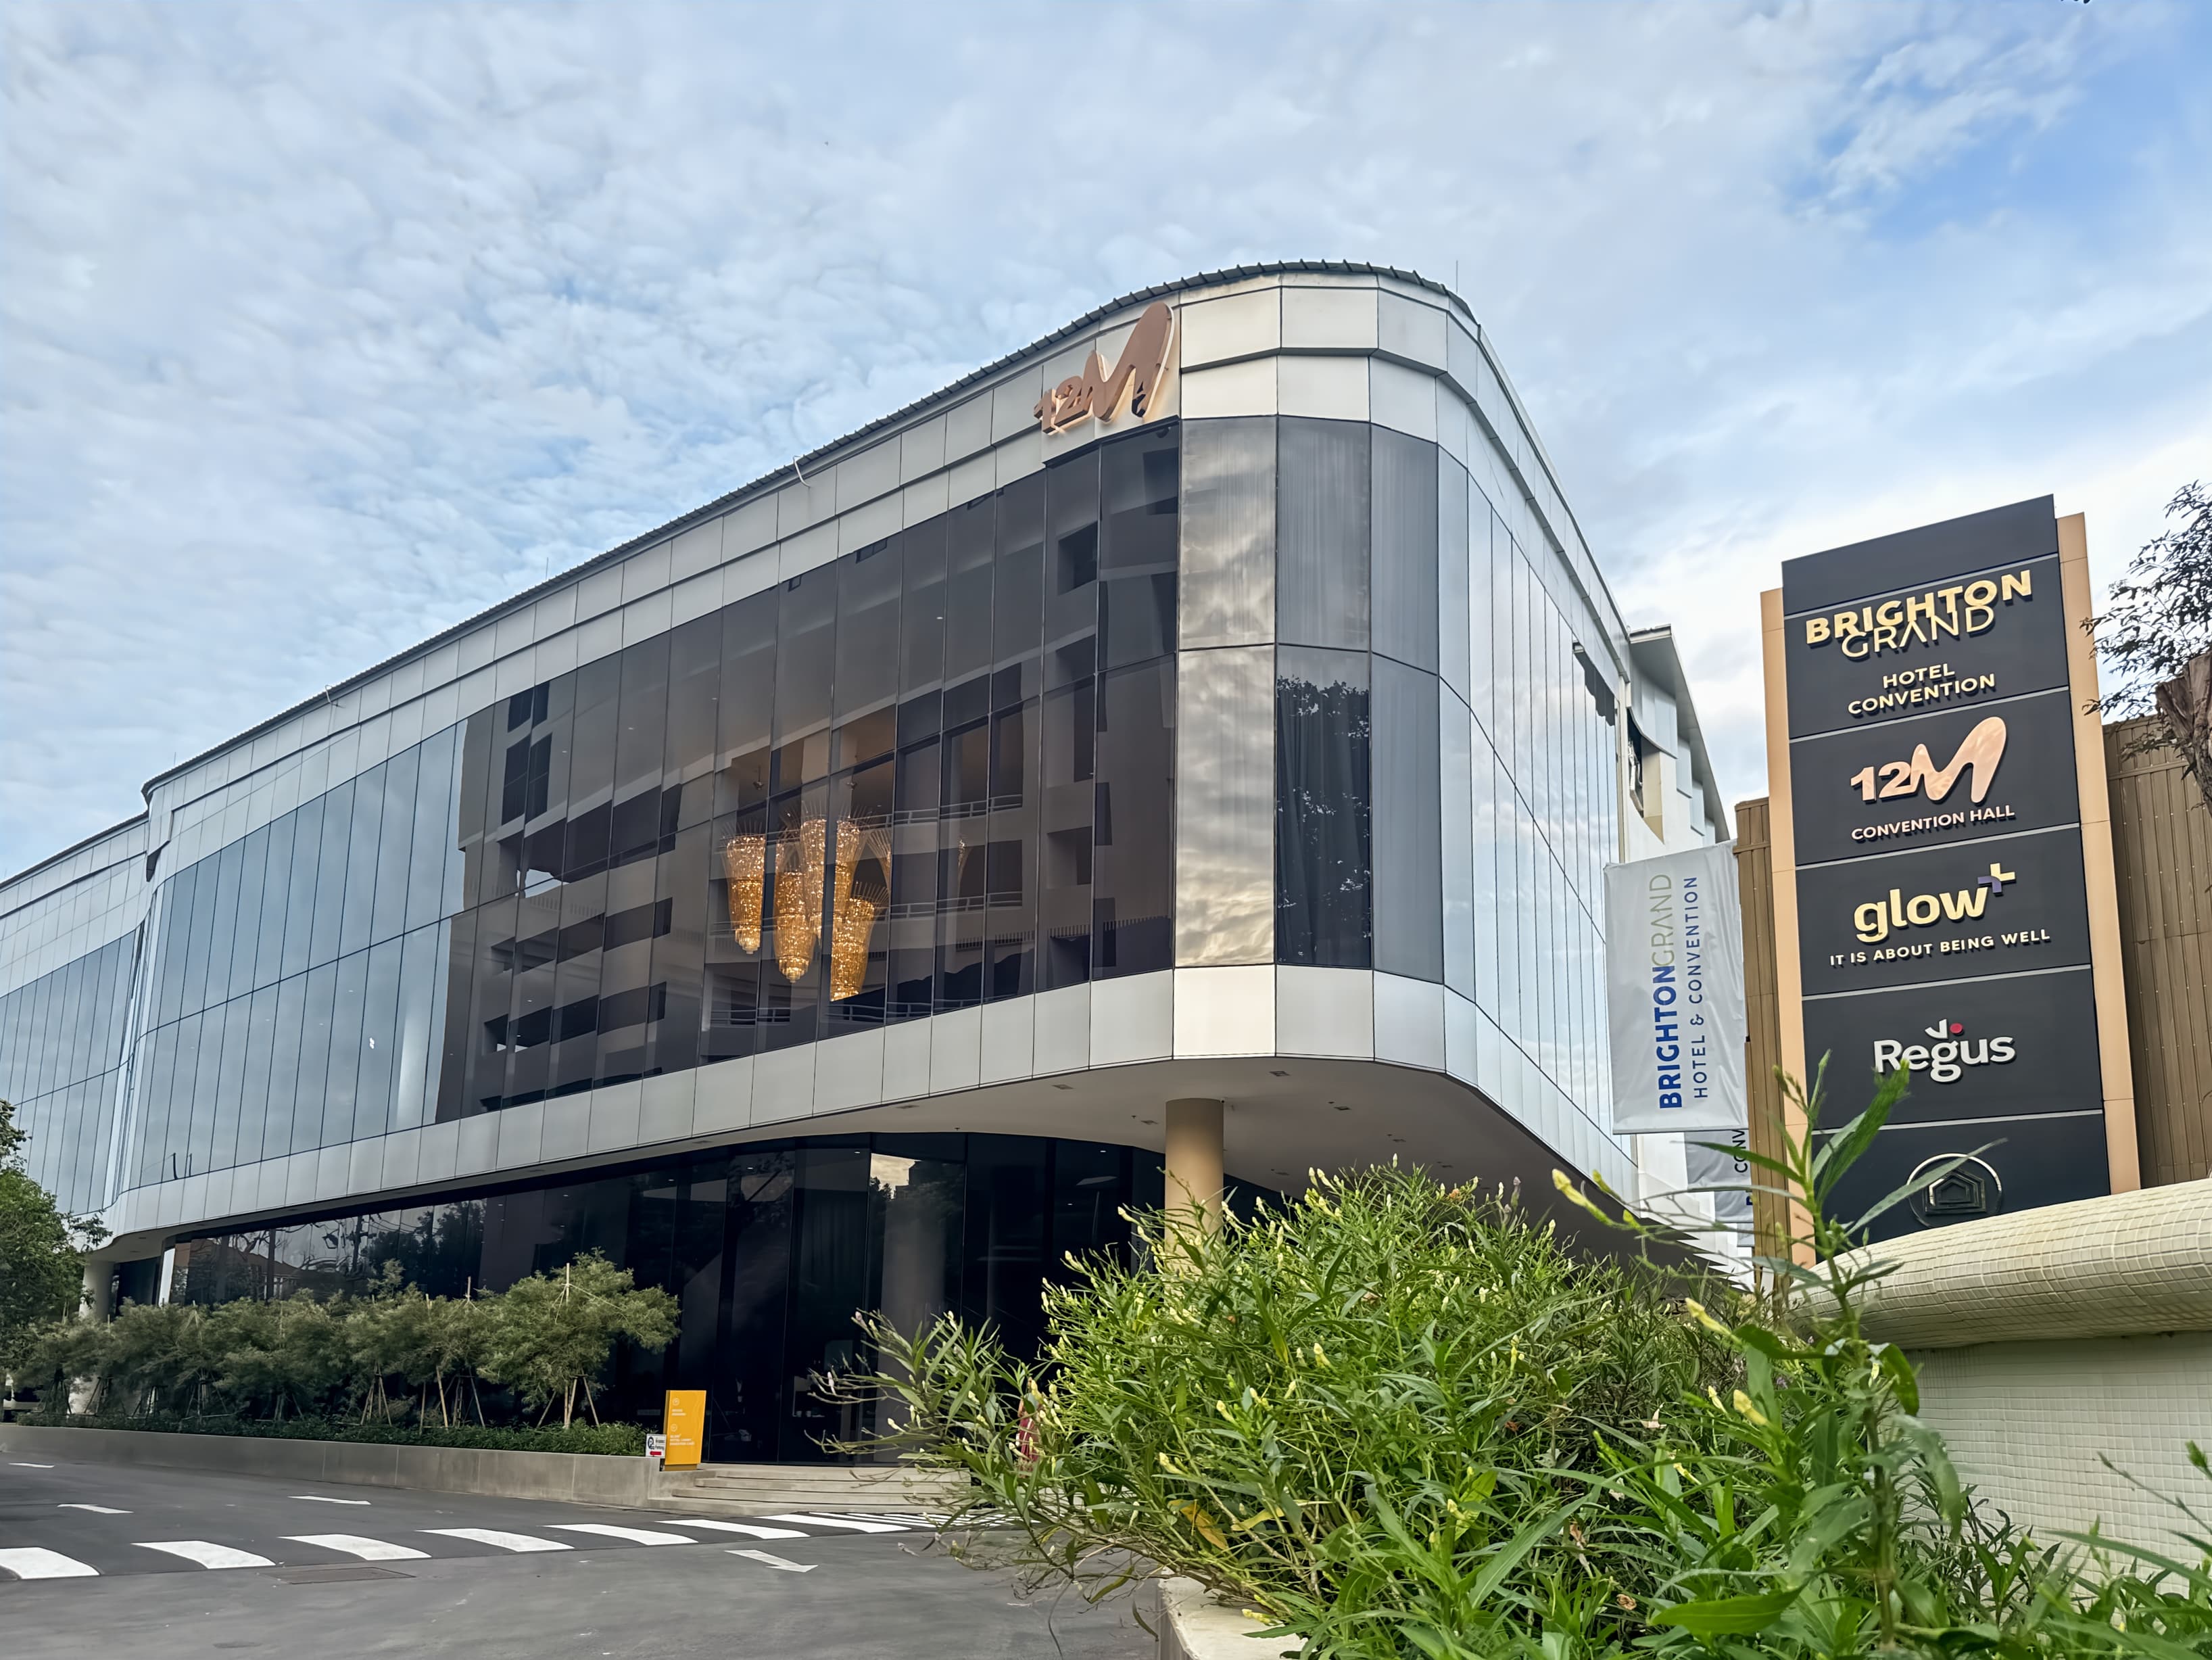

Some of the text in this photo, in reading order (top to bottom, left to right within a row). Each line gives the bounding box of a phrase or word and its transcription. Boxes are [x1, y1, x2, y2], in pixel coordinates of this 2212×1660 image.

[1034, 302, 1175, 434] 12M
[1806, 569, 2031, 644] BRIGHTON
[1841, 605, 1995, 658] GRAND
[1848, 673, 1995, 715] CONVENTION
[1883, 663, 1956, 689] HOTEL
[1850, 716, 2007, 803] 12M
[1851, 805, 2015, 840] CONVENTION HALL
[1830, 928, 2050, 966] IT IS ABOUT BEING WELL
[1683, 877, 1708, 1099] HOTEL & CONVENTION
[1873, 1036, 2016, 1083] Regus
